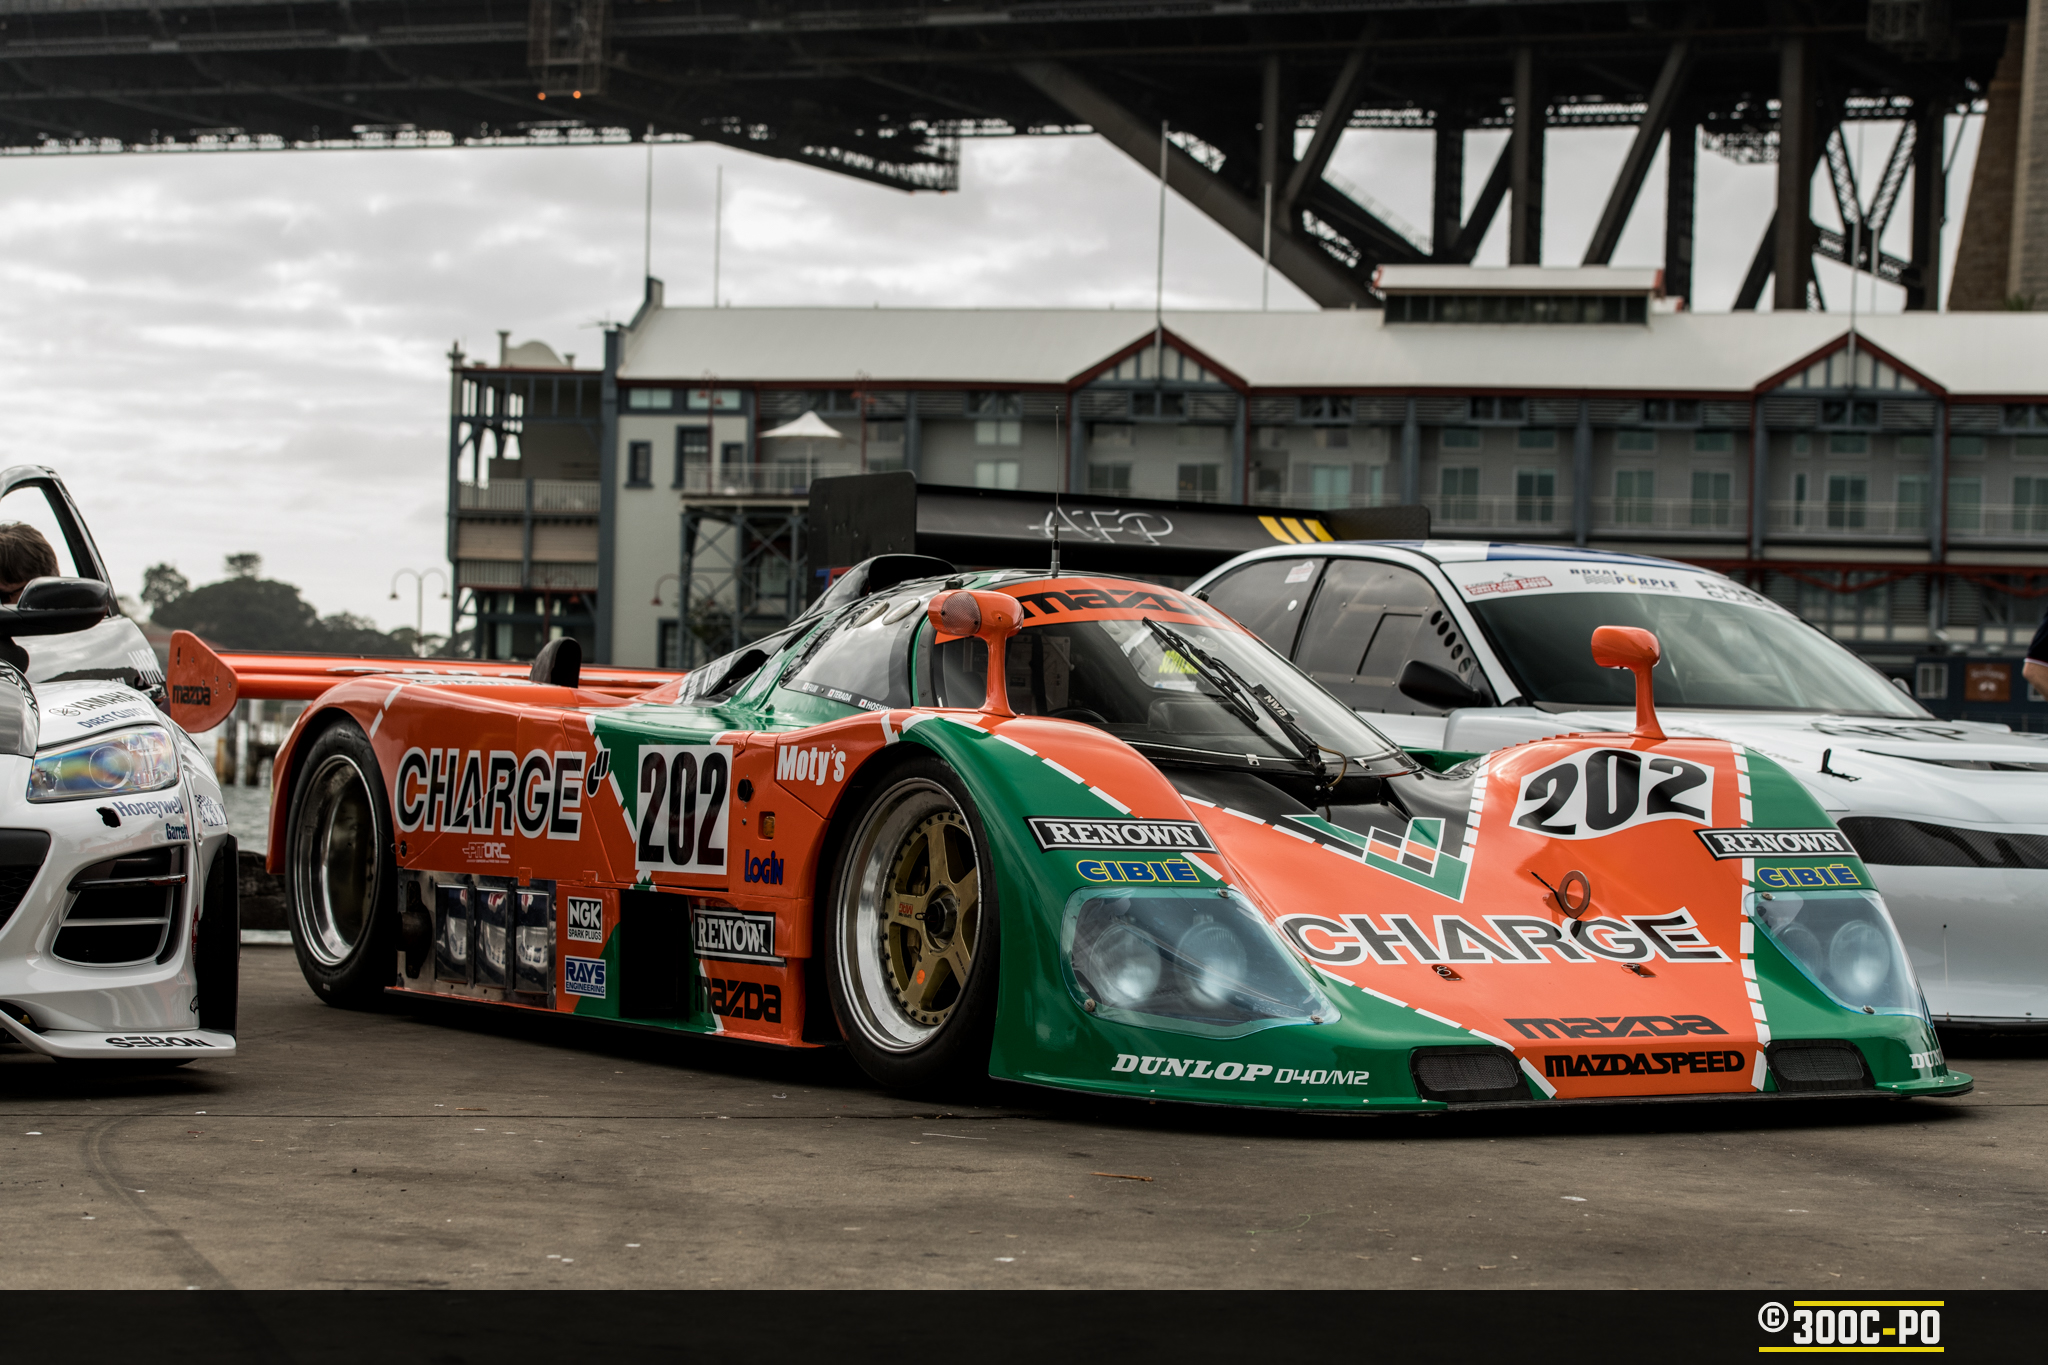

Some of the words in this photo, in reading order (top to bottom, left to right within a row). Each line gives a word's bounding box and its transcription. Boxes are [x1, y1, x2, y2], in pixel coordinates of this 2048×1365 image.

[1021, 588, 1222, 622] mazd
[65, 691, 142, 711] YAMAHA
[172, 685, 211, 706] mazda
[833, 689, 853, 703] TERADA
[866, 700, 895, 711] HOSHIN
[1264, 694, 1288, 717] NWB
[77, 711, 117, 729] DIRECT
[776, 744, 847, 786] Moty's
[394, 746, 587, 841] CHARGE
[1516, 750, 1708, 835] 202
[112, 796, 184, 818] Honeywell
[638, 751, 729, 866] 202
[165, 823, 190, 840] Garrett
[1044, 822, 1200, 846] RENOWN
[1713, 832, 1846, 853] RENOWN
[1076, 858, 1200, 882] CIBIÉ
[1757, 863, 1862, 887] CIBIÉ
[569, 901, 601, 929] NGK
[568, 928, 584, 939] SPARK
[584, 931, 601, 942] PLUGS
[1274, 905, 1734, 965] CHARGE
[566, 961, 605, 984] RAYS
[566, 981, 605, 994] ENGINEERING
[694, 974, 782, 1024] mazda
[1503, 1014, 1730, 1040] mazda
[1111, 1053, 1274, 1082] DUNLOP
[1274, 1068, 1370, 1086] D40/M2
[1544, 1050, 1746, 1077] MAZDASPEED
